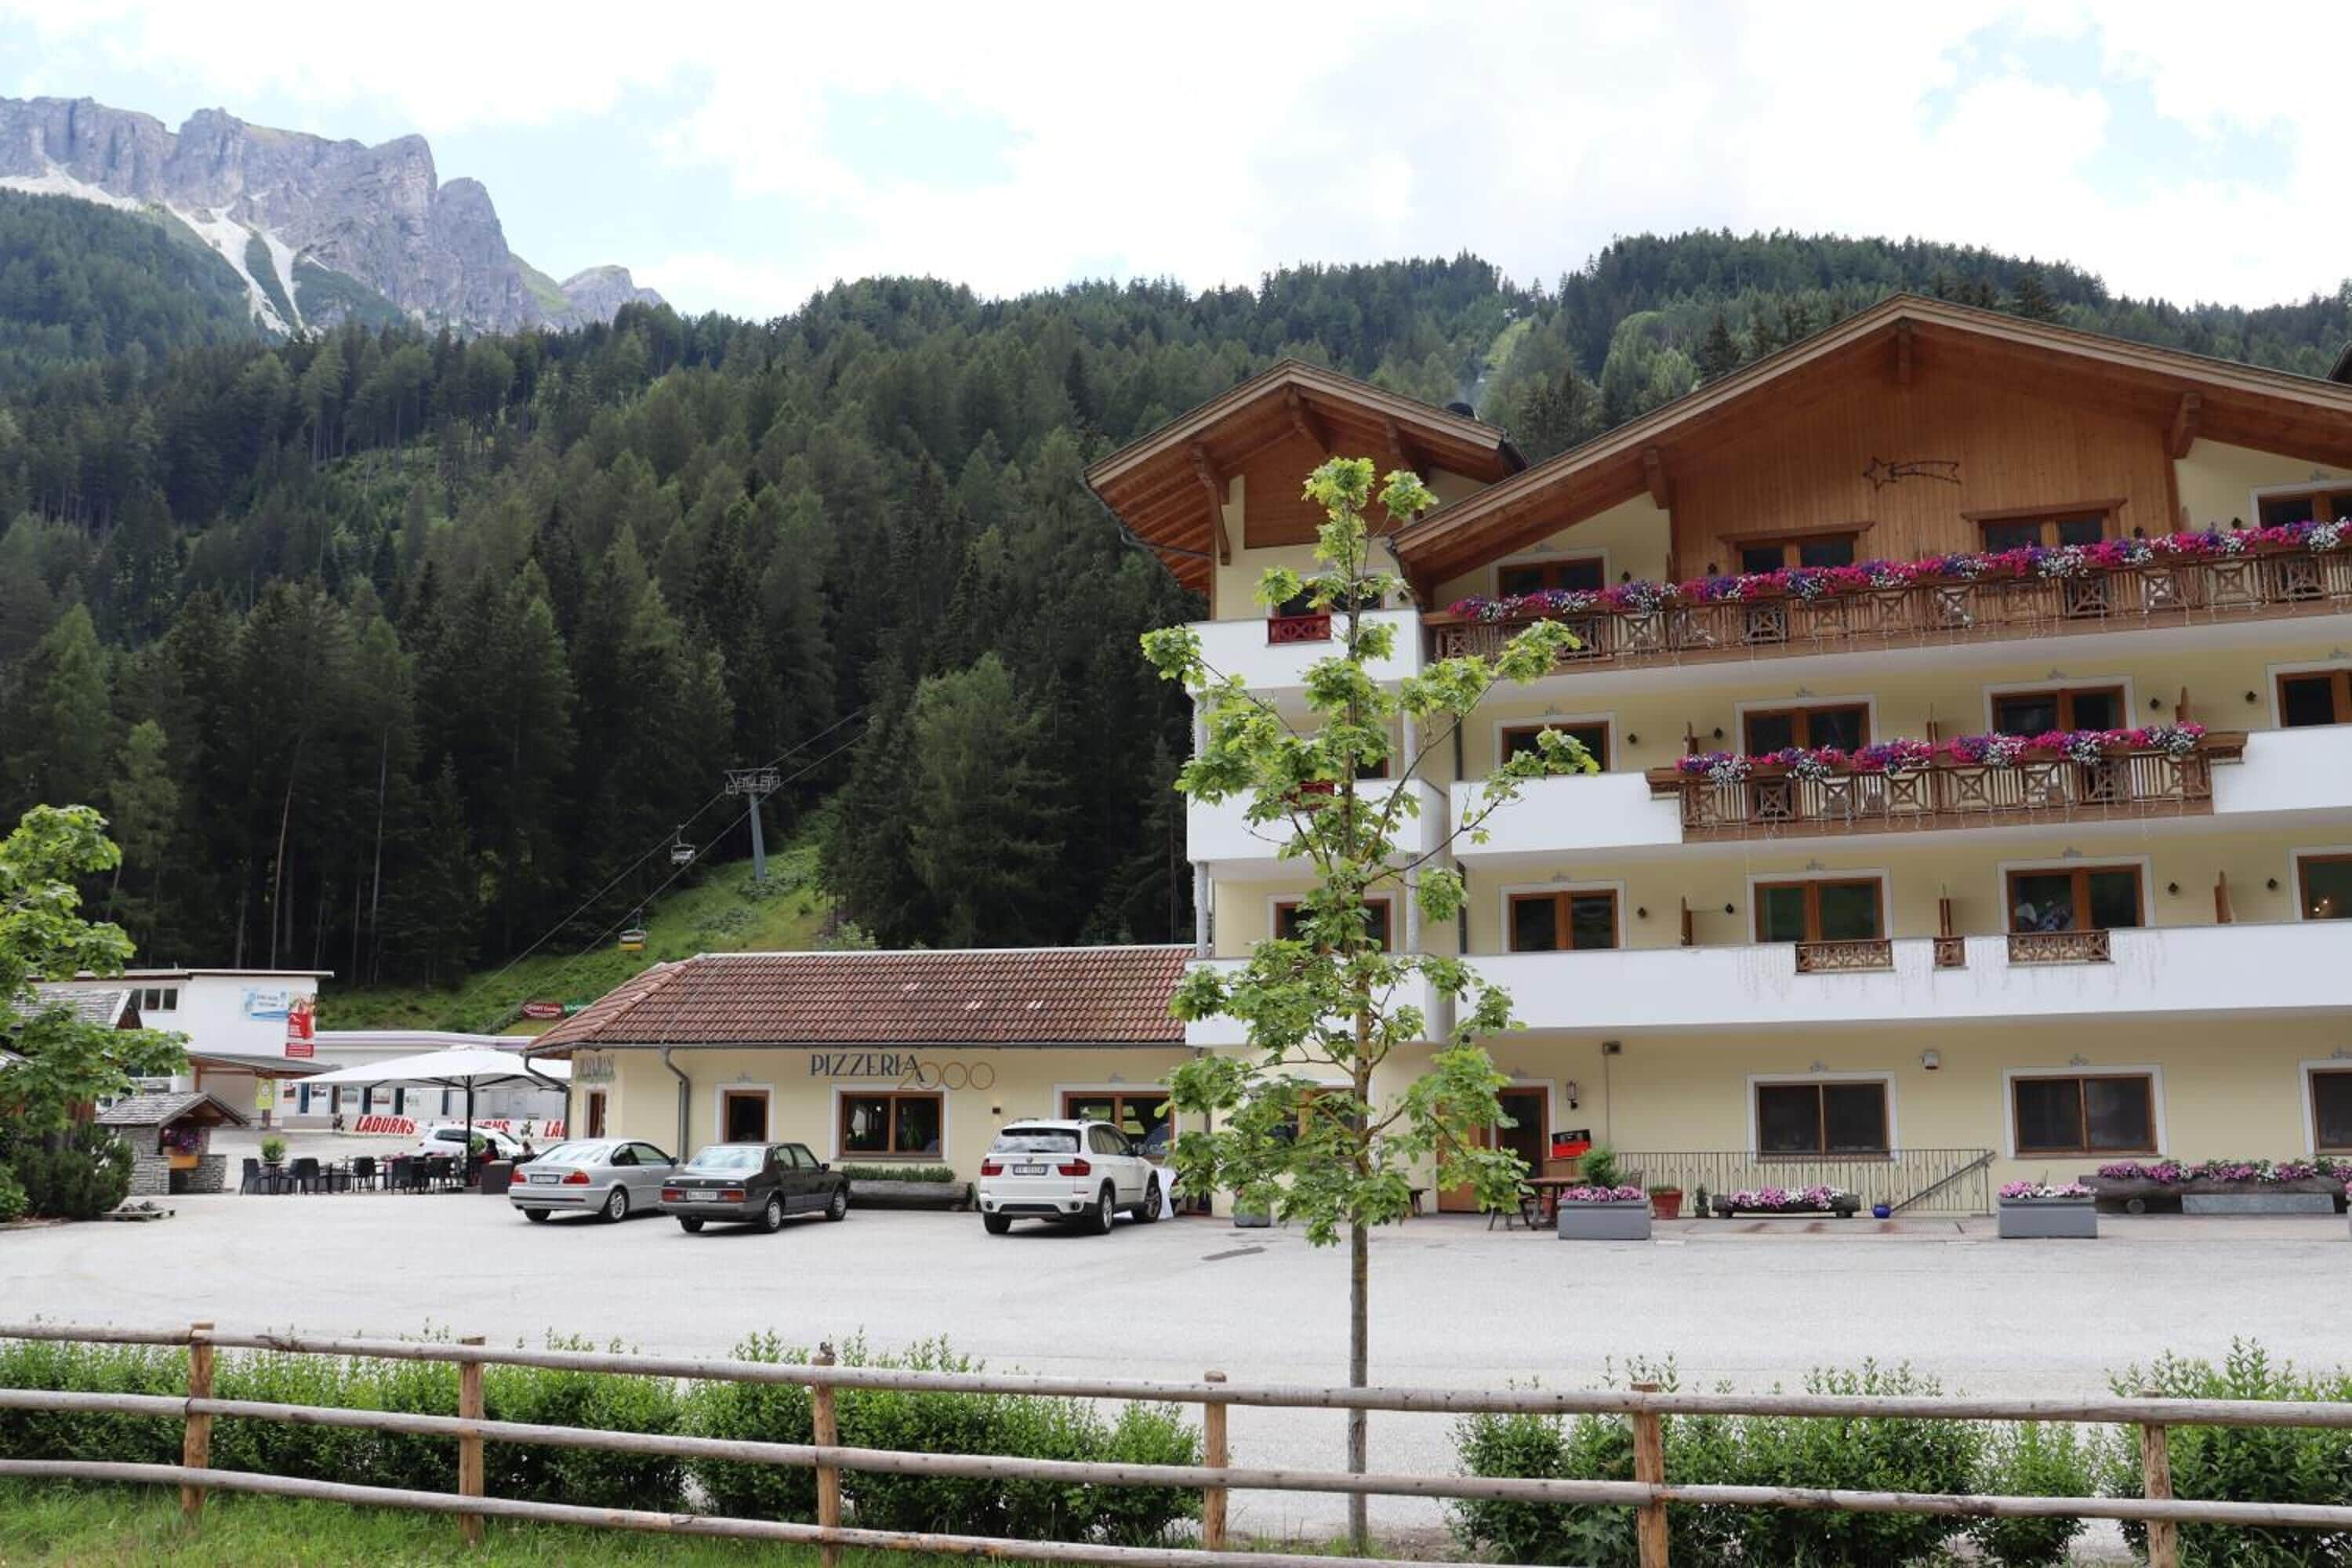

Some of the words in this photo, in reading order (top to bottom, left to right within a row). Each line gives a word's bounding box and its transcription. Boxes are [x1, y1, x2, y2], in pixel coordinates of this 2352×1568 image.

[811, 1053, 925, 1083] PIZZERIA
[897, 1061, 995, 1091] 2000
[354, 1116, 415, 1134] LADURNS
